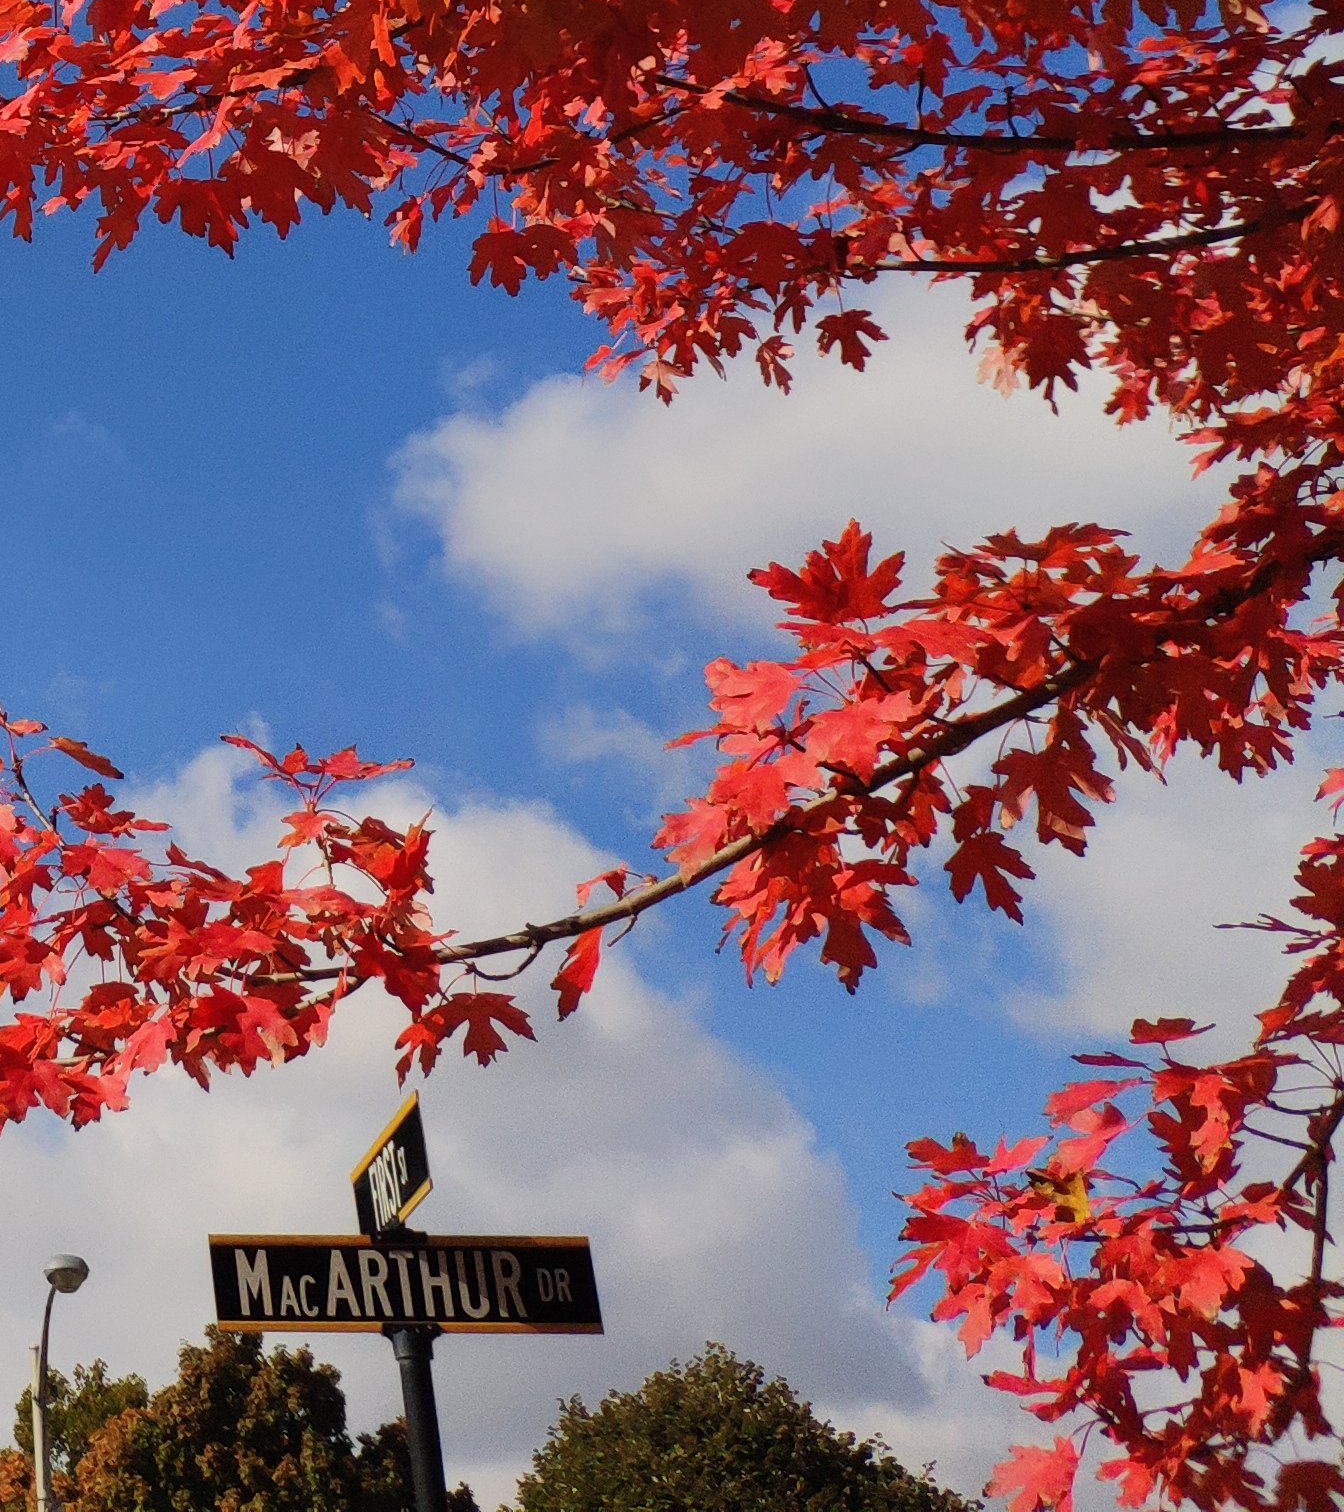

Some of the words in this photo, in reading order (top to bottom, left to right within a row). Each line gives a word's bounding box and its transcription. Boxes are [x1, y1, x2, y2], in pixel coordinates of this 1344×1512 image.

[367, 1139, 402, 1232] FIRST
[396, 1145, 409, 1185] ST
[535, 1267, 574, 1303] DR
